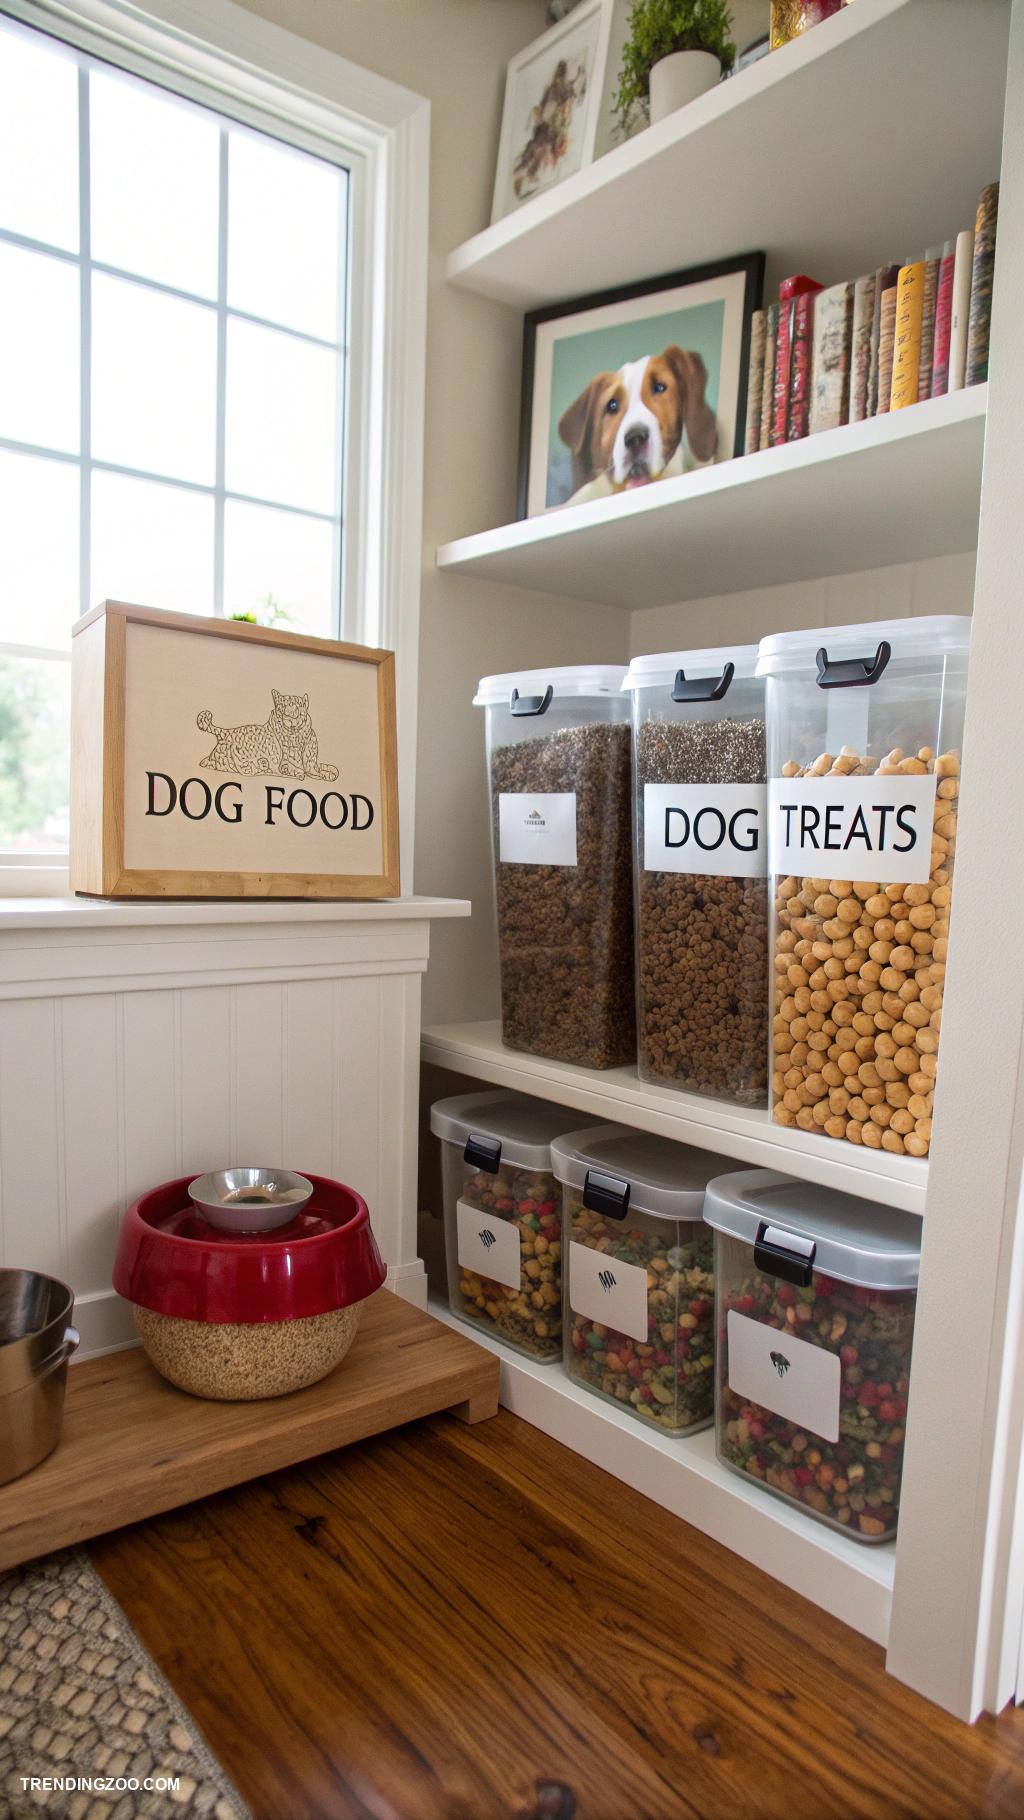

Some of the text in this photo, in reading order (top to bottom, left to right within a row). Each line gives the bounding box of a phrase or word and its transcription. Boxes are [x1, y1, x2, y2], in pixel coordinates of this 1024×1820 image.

[145, 771, 374, 831] DOG FOOD
[664, 804, 917, 852] DOG TREATS
